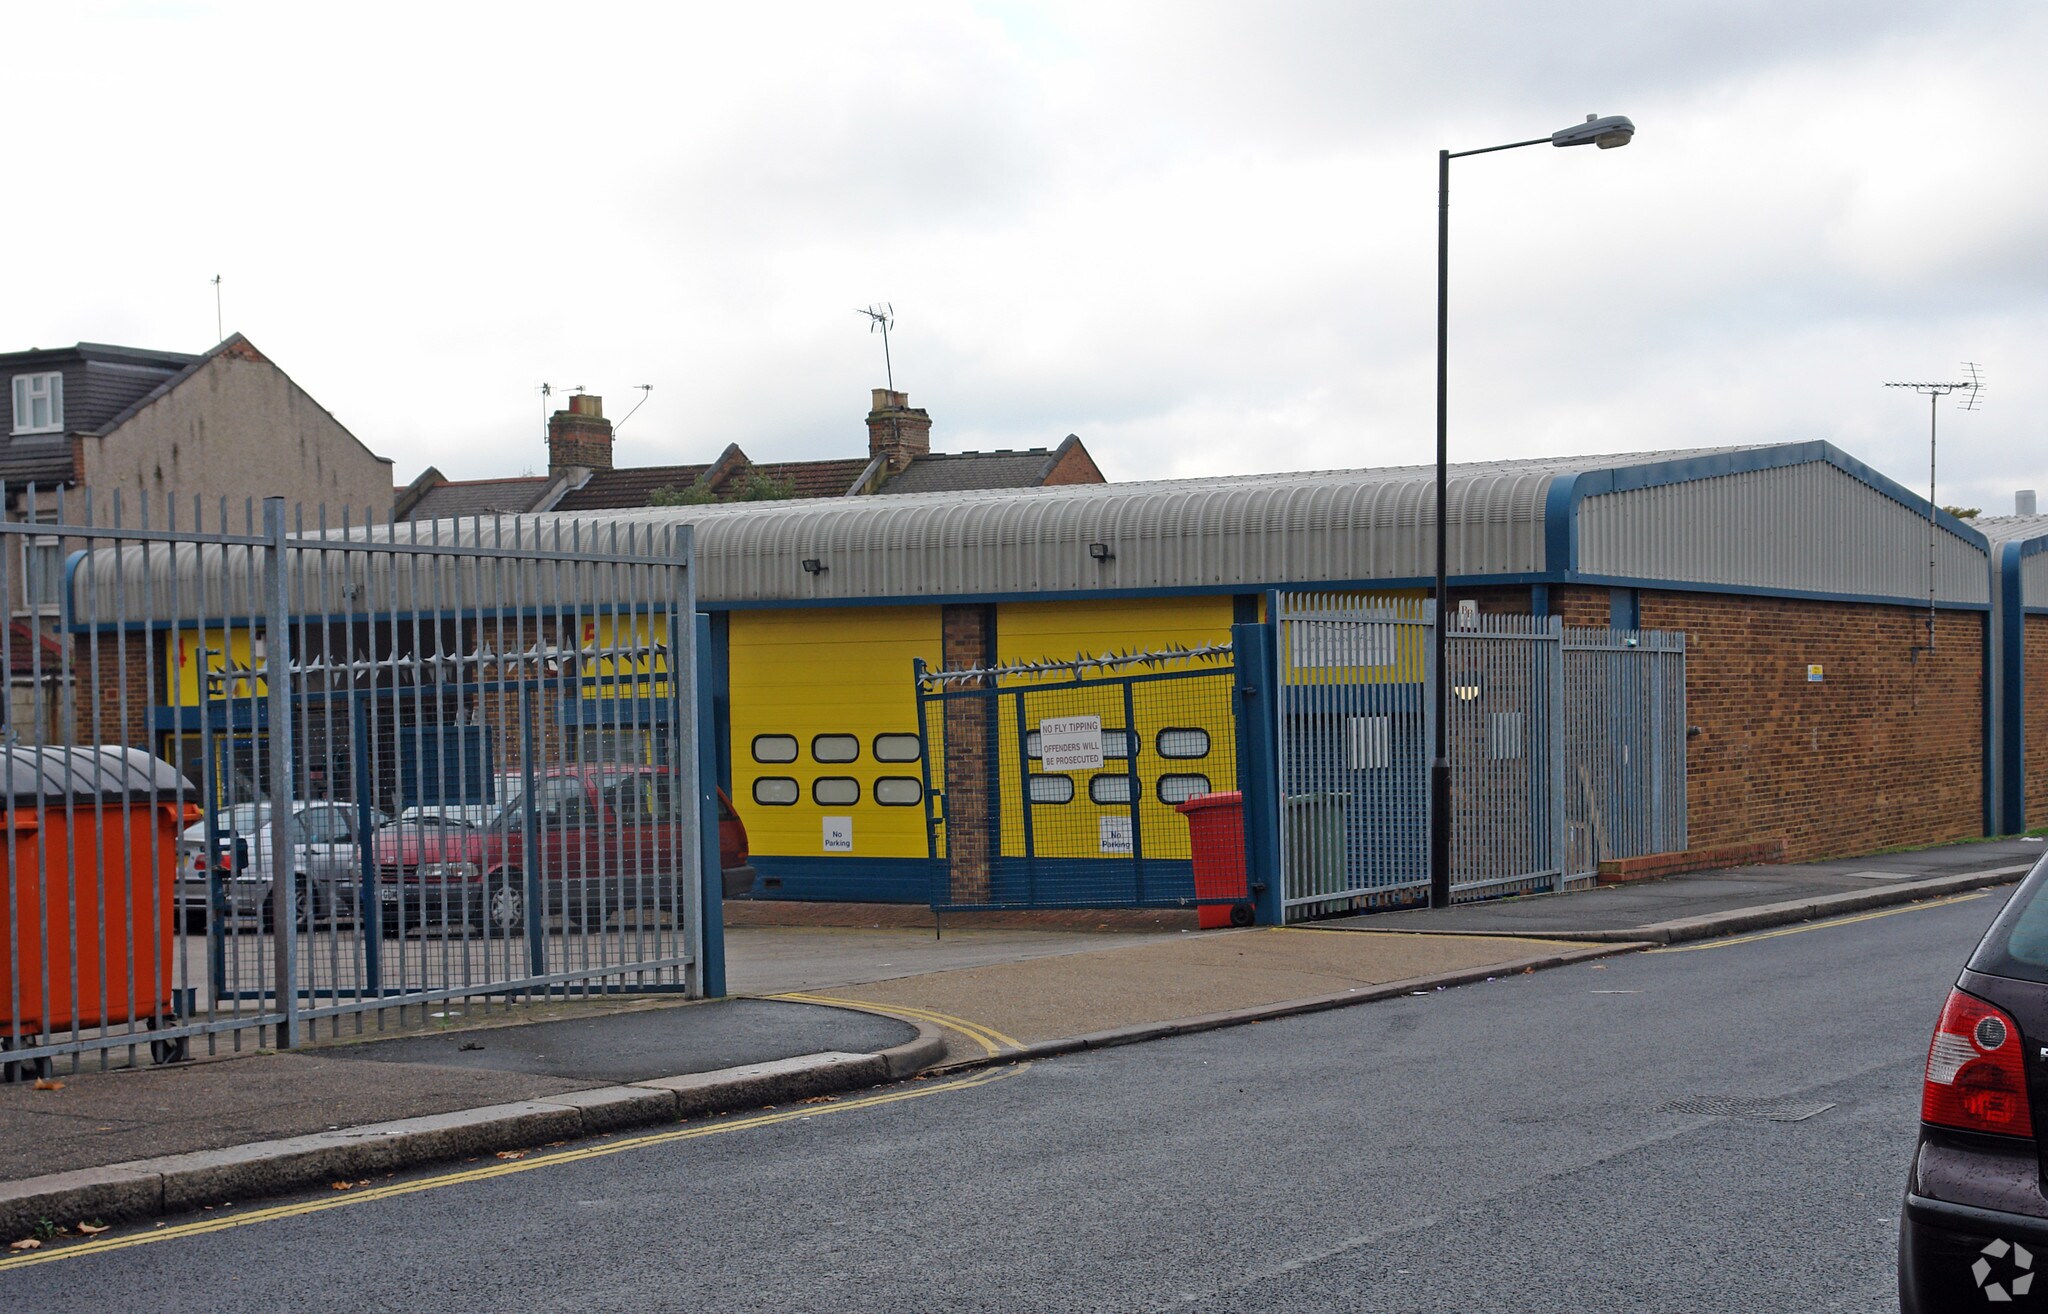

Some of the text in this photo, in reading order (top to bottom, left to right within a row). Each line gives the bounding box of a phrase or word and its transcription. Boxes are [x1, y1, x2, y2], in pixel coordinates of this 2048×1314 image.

[1043, 721, 1098, 733] NO FLY TIPPING
[1044, 742, 1099, 753] OFFENDERS WILL
[1046, 755, 1099, 766] BE PROSECUTED
[825, 840, 850, 848] Parking
[1102, 840, 1130, 849] Parking
